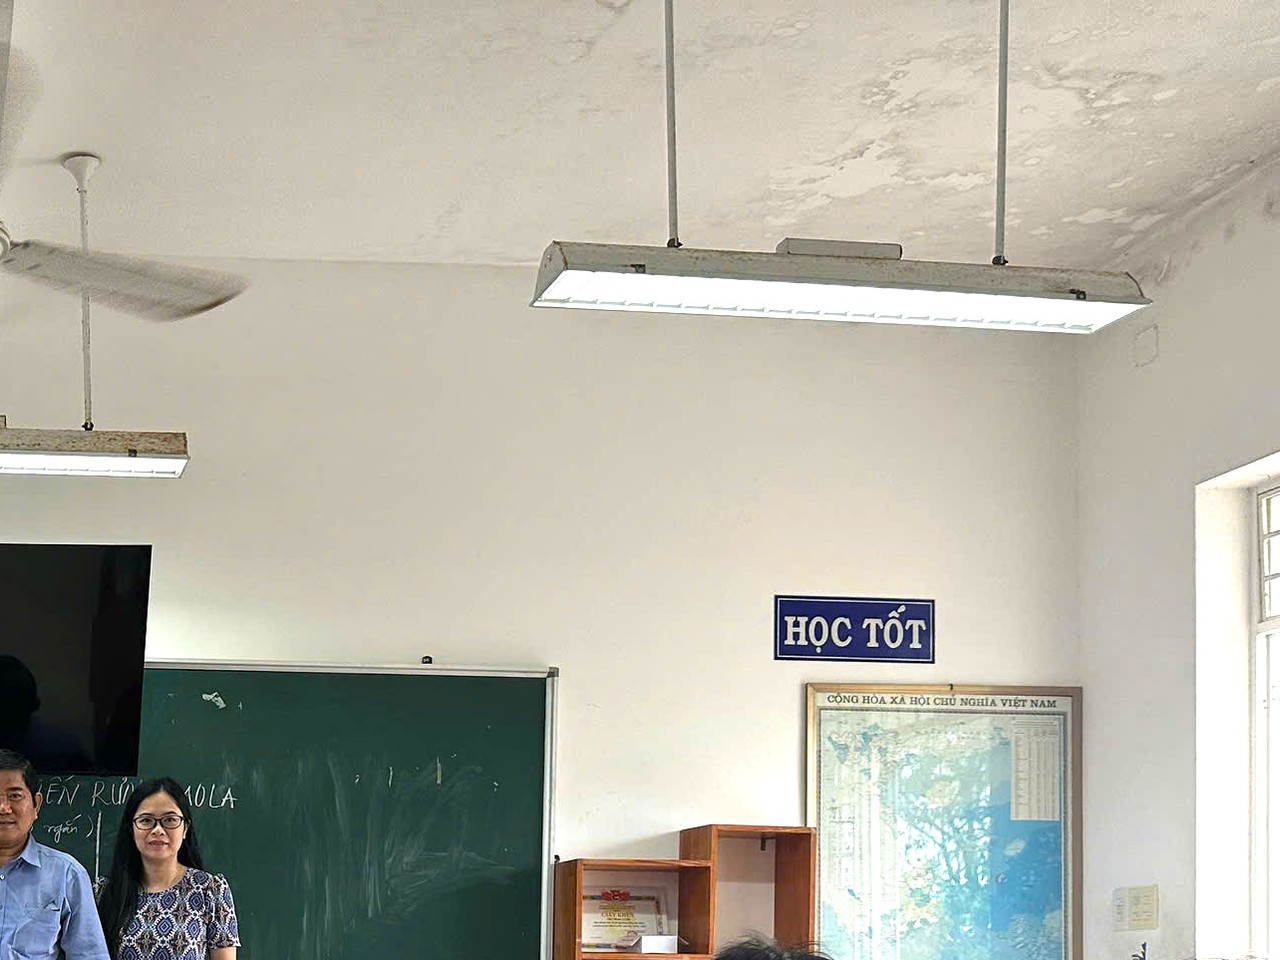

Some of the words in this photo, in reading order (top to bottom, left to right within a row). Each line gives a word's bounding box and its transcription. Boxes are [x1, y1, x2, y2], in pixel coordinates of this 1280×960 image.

[784, 616, 853, 654] HỌC
[862, 604, 927, 649] TỐT
[827, 692, 859, 705] CỘNG
[862, 693, 887, 705] HÒA
[889, 694, 906, 705] XÃ
[909, 695, 930, 706] HỘI
[933, 694, 957, 706] CHỦ
[960, 697, 998, 707] NGHĨA
[1000, 697, 1027, 709] VIỆT
[1030, 699, 1057, 708] NAM
